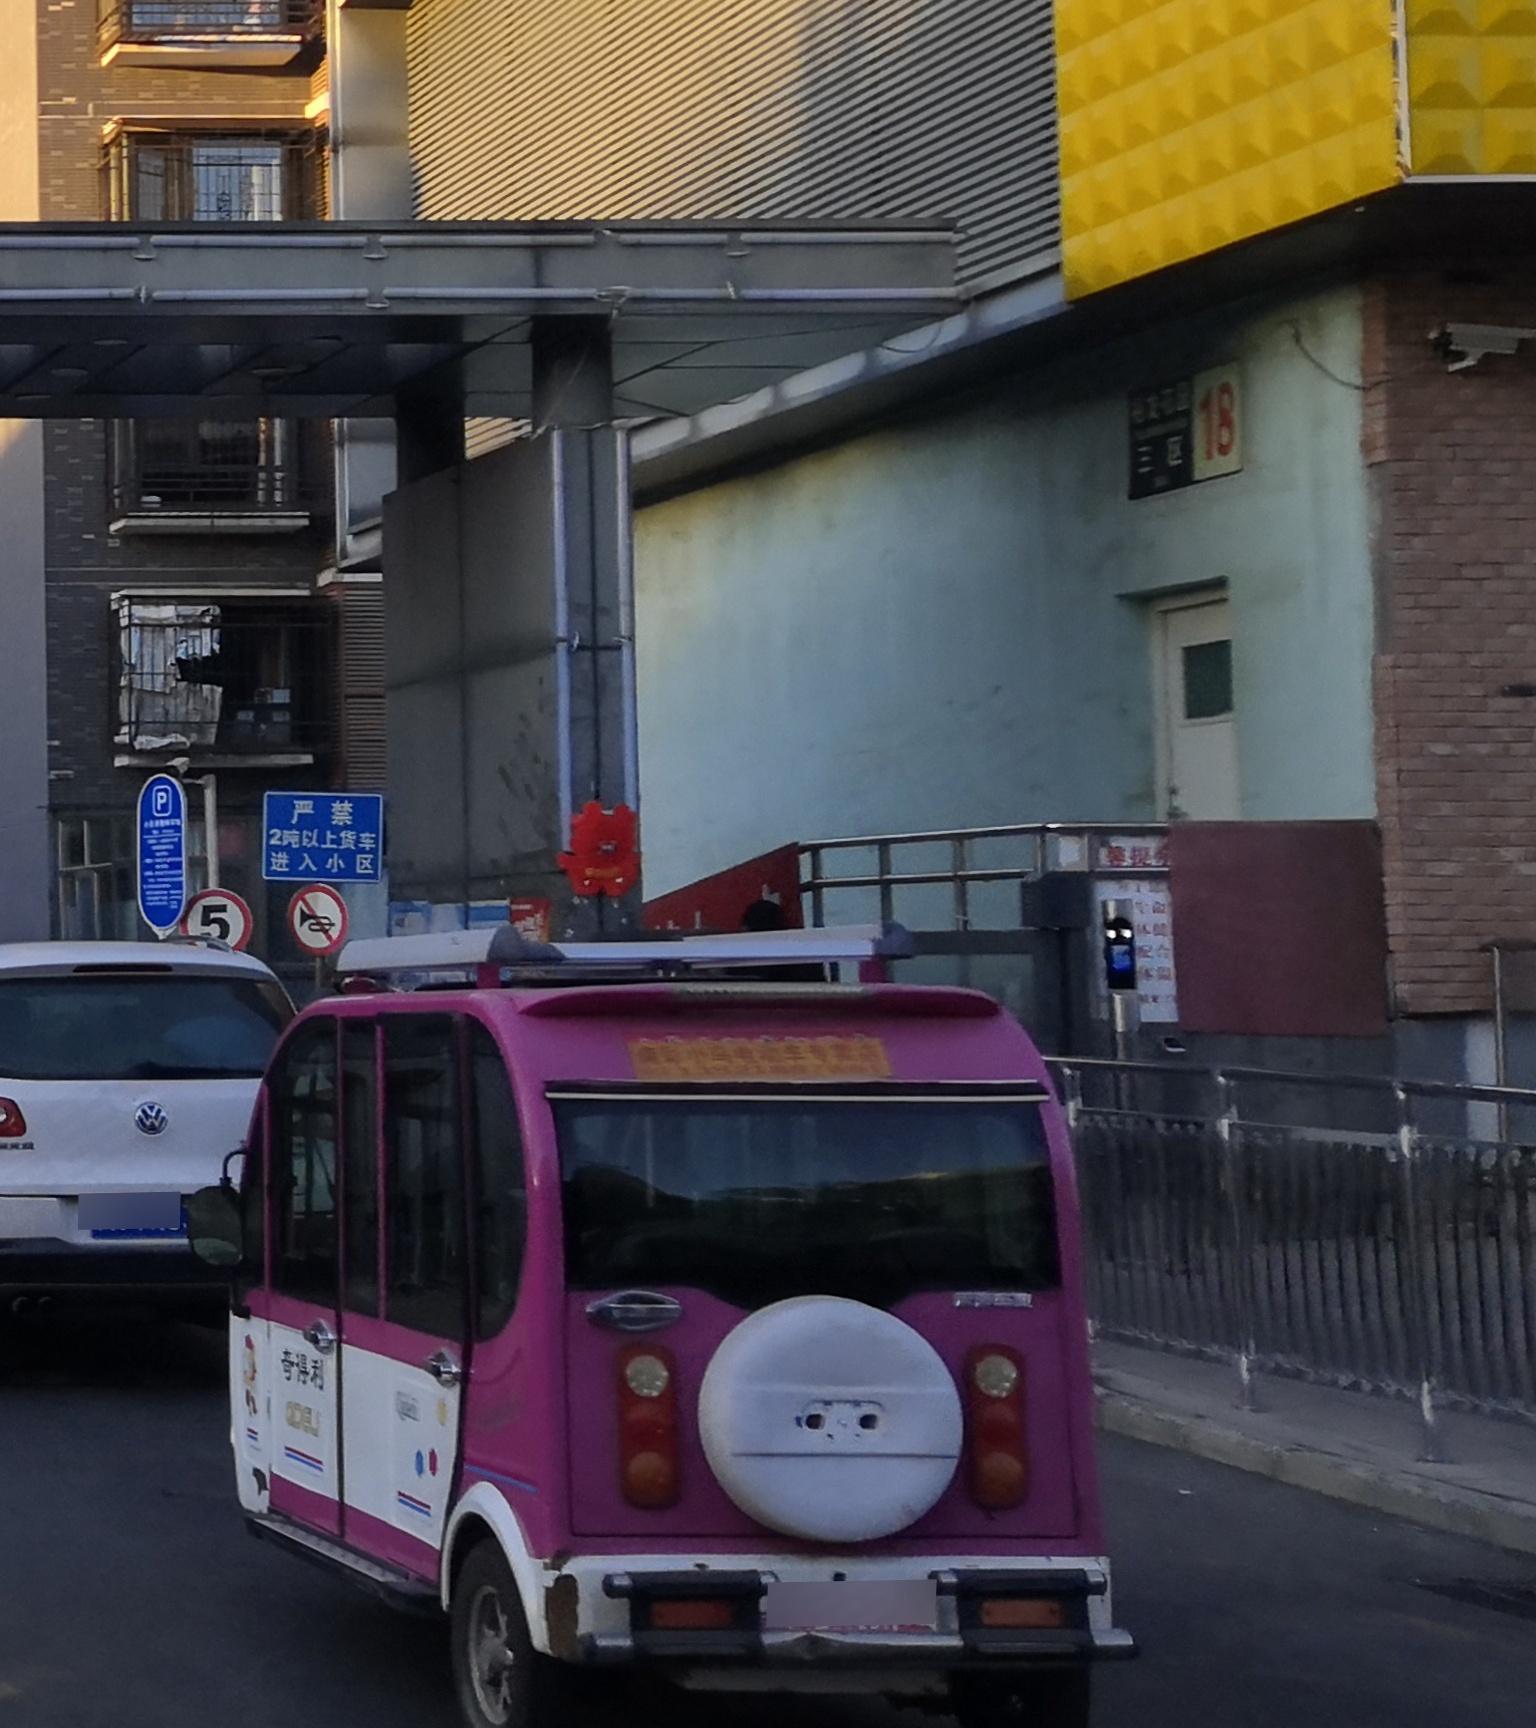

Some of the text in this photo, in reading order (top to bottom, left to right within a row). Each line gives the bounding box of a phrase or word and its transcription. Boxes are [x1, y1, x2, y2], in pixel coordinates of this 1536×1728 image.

[1199, 381, 1234, 461] 18
[291, 799, 354, 826] 严禁
[269, 828, 376, 851] 2吨以上货车
[270, 852, 374, 874] 进入小区
[200, 904, 231, 940] 5
